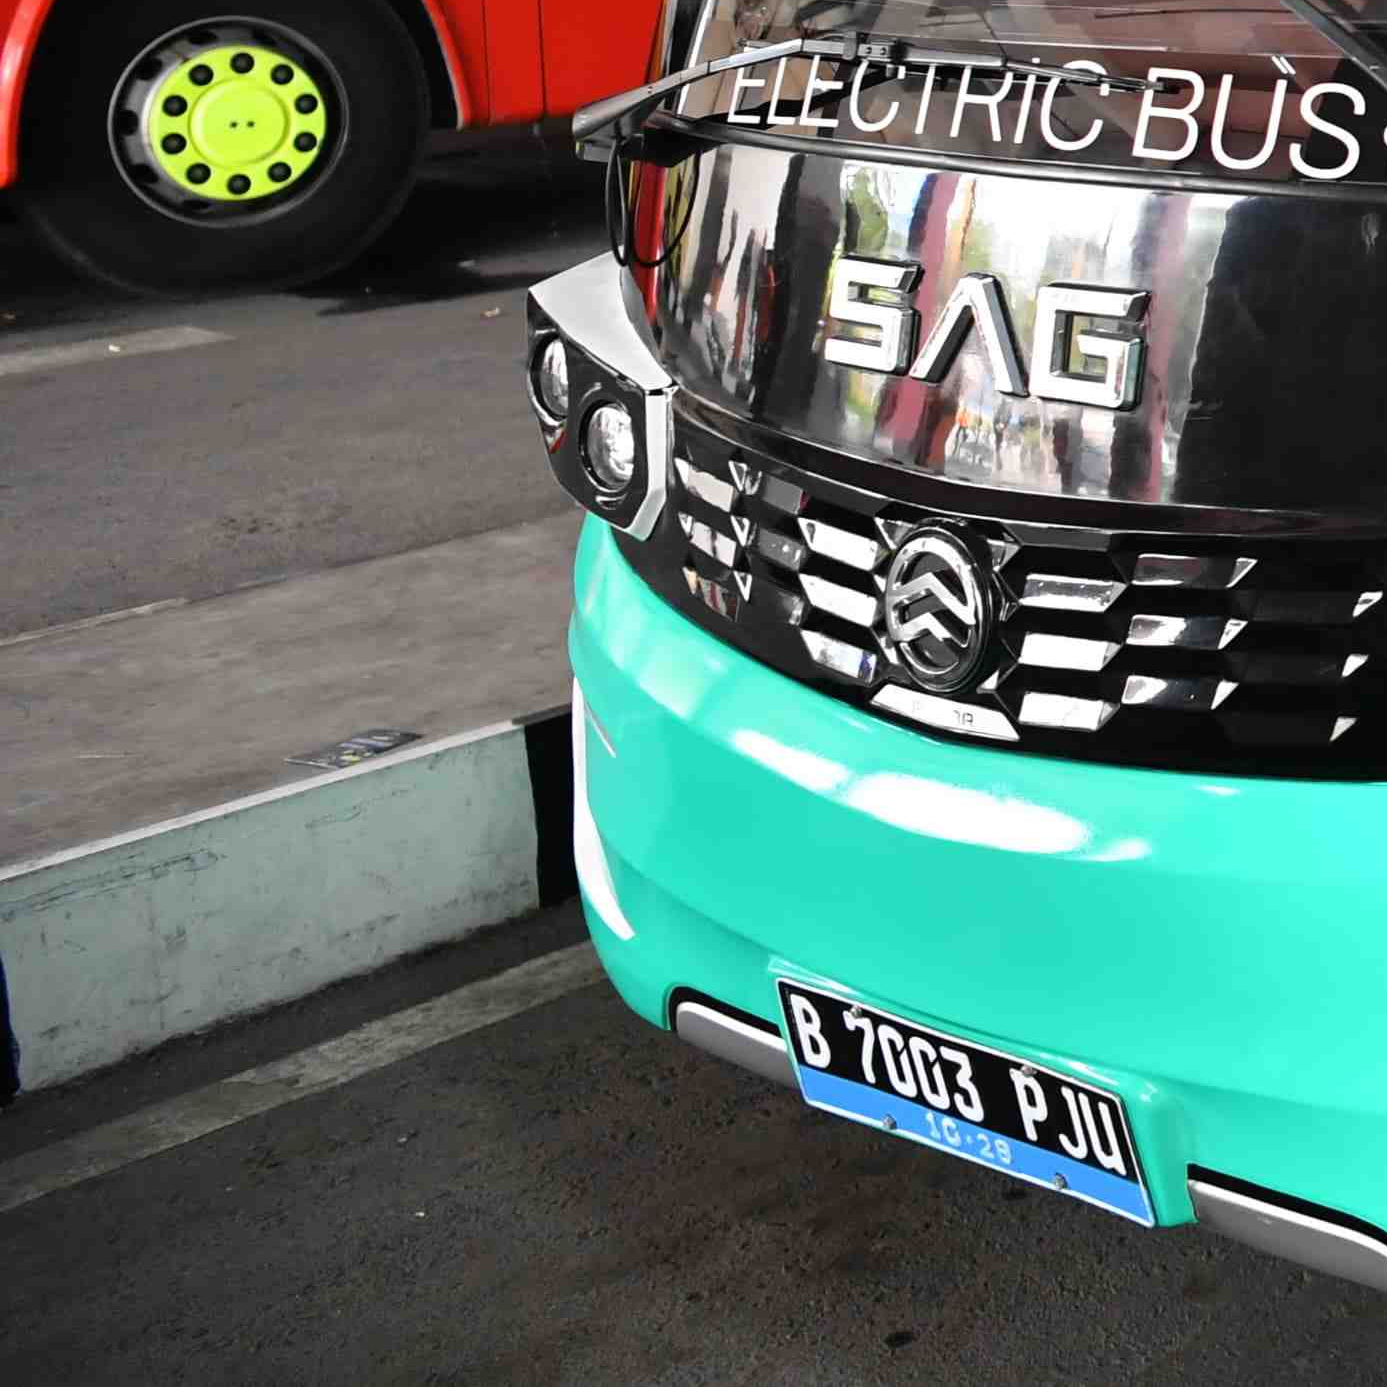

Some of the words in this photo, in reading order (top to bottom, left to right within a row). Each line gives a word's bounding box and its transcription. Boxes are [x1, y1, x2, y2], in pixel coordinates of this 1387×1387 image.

[727, 47, 1110, 152] ELECTRIC
[1132, 66, 1368, 180] BUS
[823, 254, 1151, 412] SAG
[789, 993, 832, 1071] B
[842, 1010, 985, 1123] 7003
[1009, 1068, 1128, 1177] PJU
